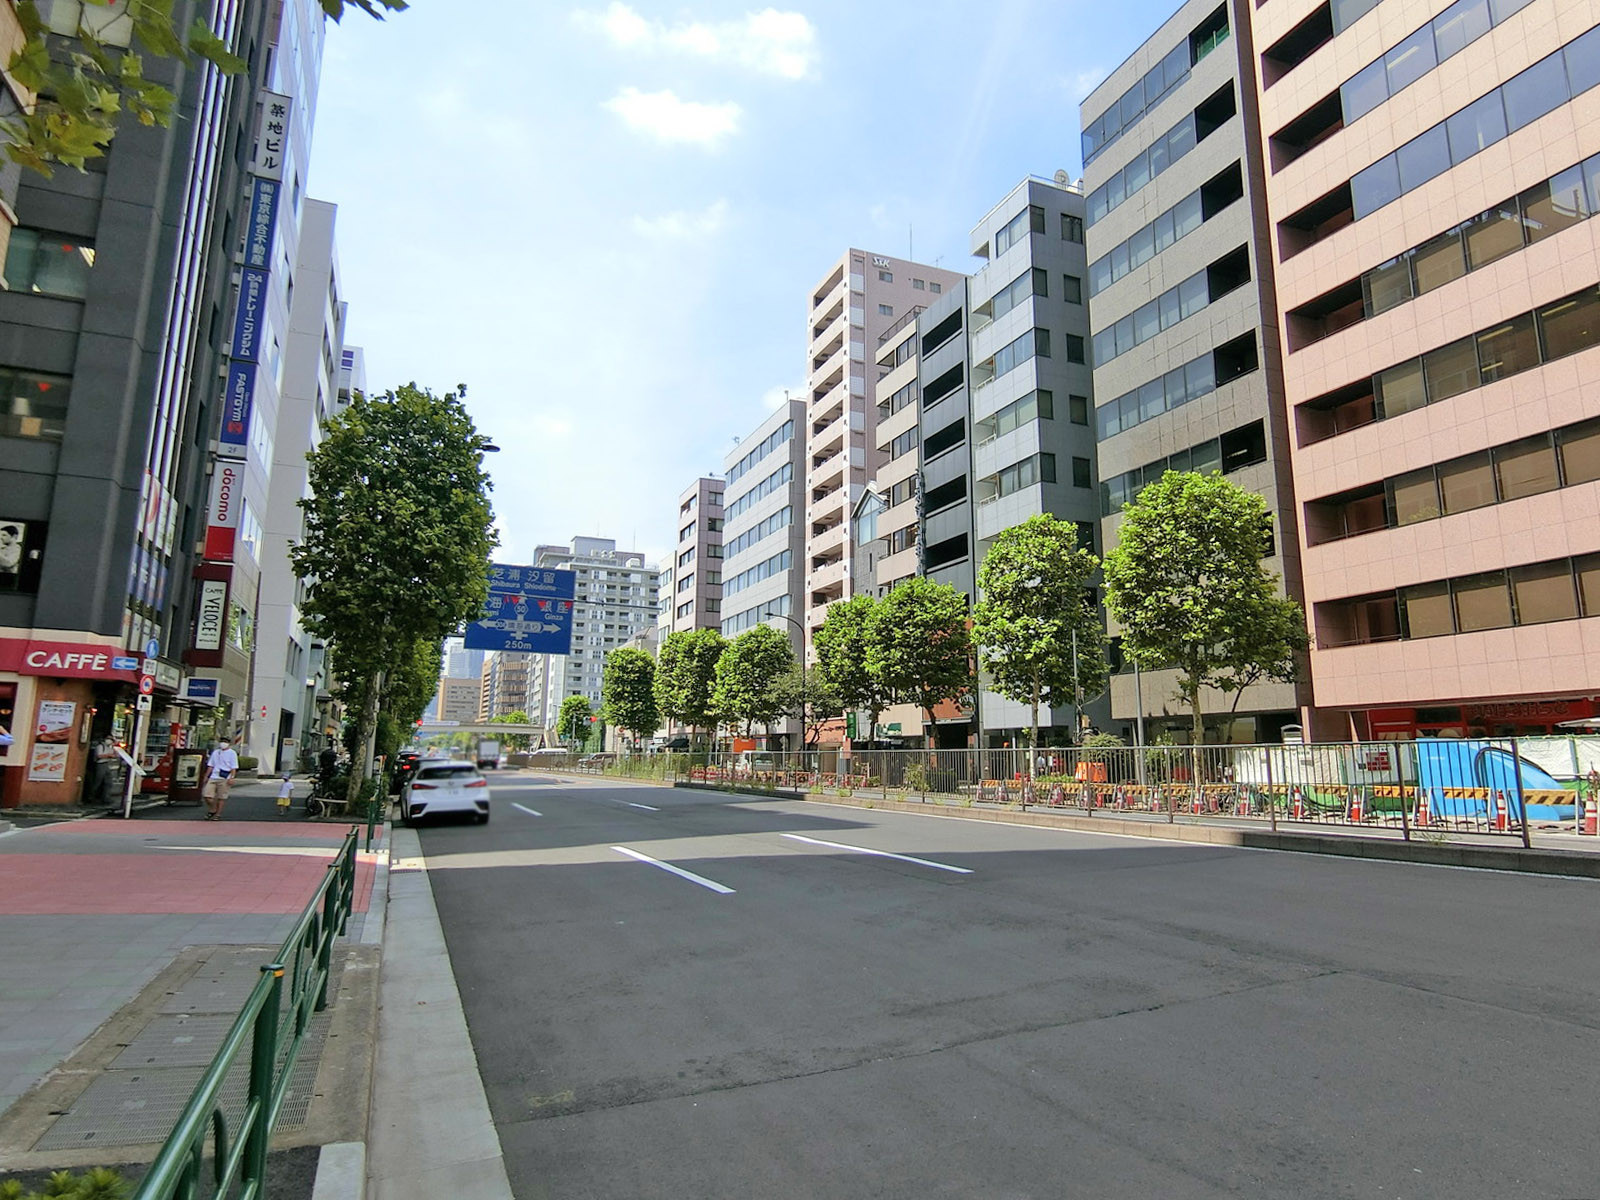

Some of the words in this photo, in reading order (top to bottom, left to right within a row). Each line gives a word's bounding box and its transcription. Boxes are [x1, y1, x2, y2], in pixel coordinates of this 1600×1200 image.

[263, 102, 286, 170] 築地ビル
[217, 467, 236, 522] docomo
[493, 568, 520, 580] 芝浦
[527, 570, 556, 584] 汐留
[203, 597, 221, 633] VELOCE
[544, 613, 564, 621] Ginza
[505, 640, 532, 650] 250m
